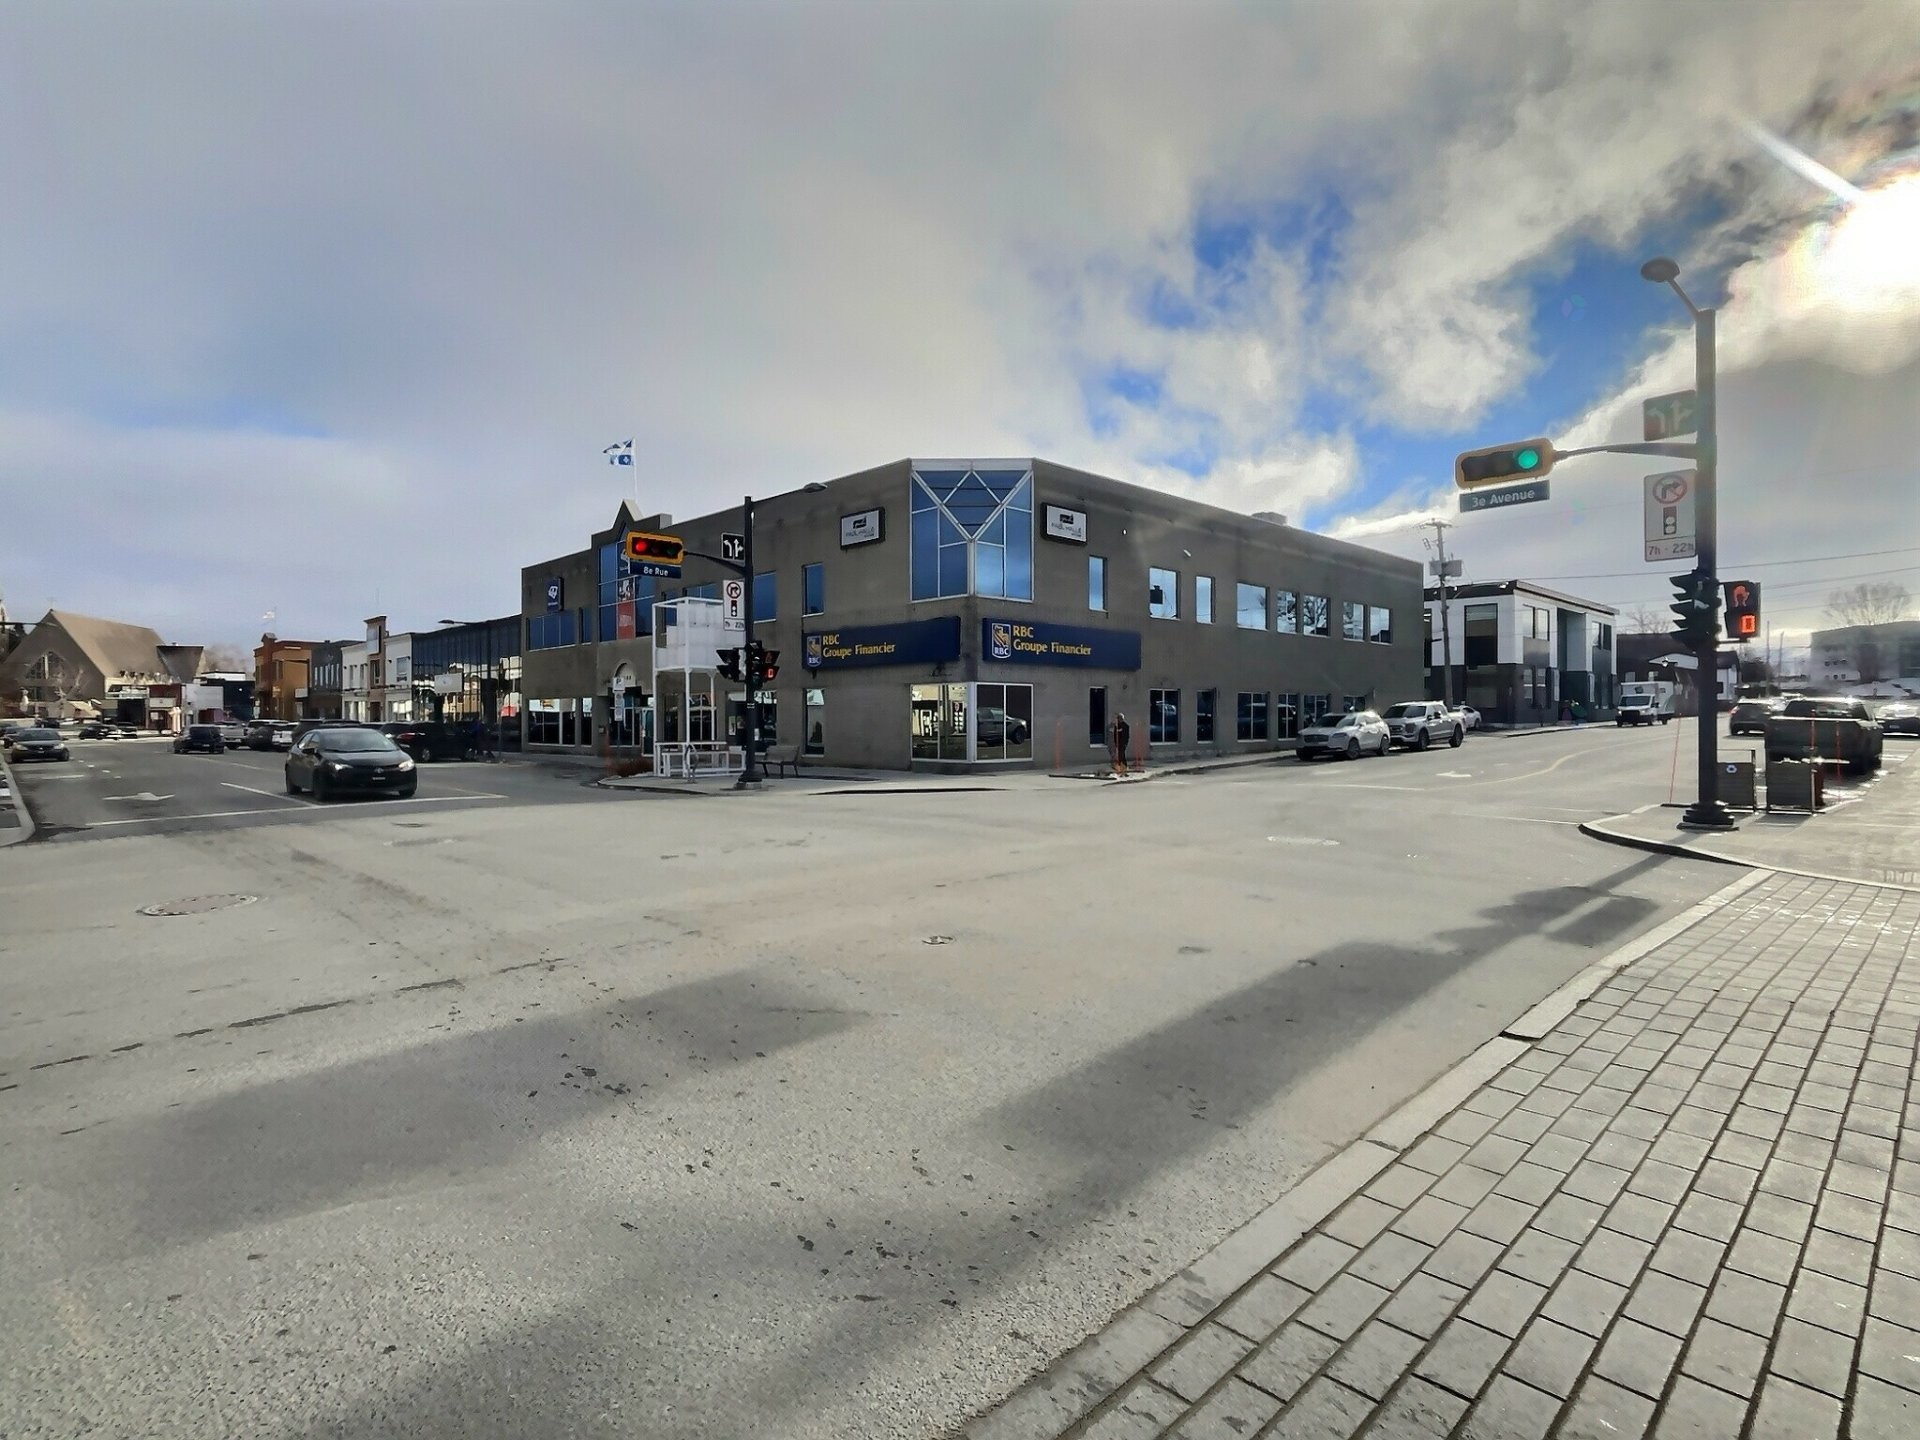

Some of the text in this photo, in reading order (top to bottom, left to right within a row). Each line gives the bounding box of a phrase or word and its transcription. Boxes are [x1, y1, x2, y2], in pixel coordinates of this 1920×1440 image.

[1472, 489, 1536, 508] 3e Avenue
[1649, 545, 1661, 556] 7h
[643, 566, 669, 577] 8e Rue
[1012, 625, 1034, 638] RBC
[822, 634, 840, 646] RBC
[823, 641, 896, 660] Groupe Financier
[994, 647, 1009, 656] RBC
[1013, 639, 1092, 656] Groupe Financier
[808, 657, 820, 665] RBC
